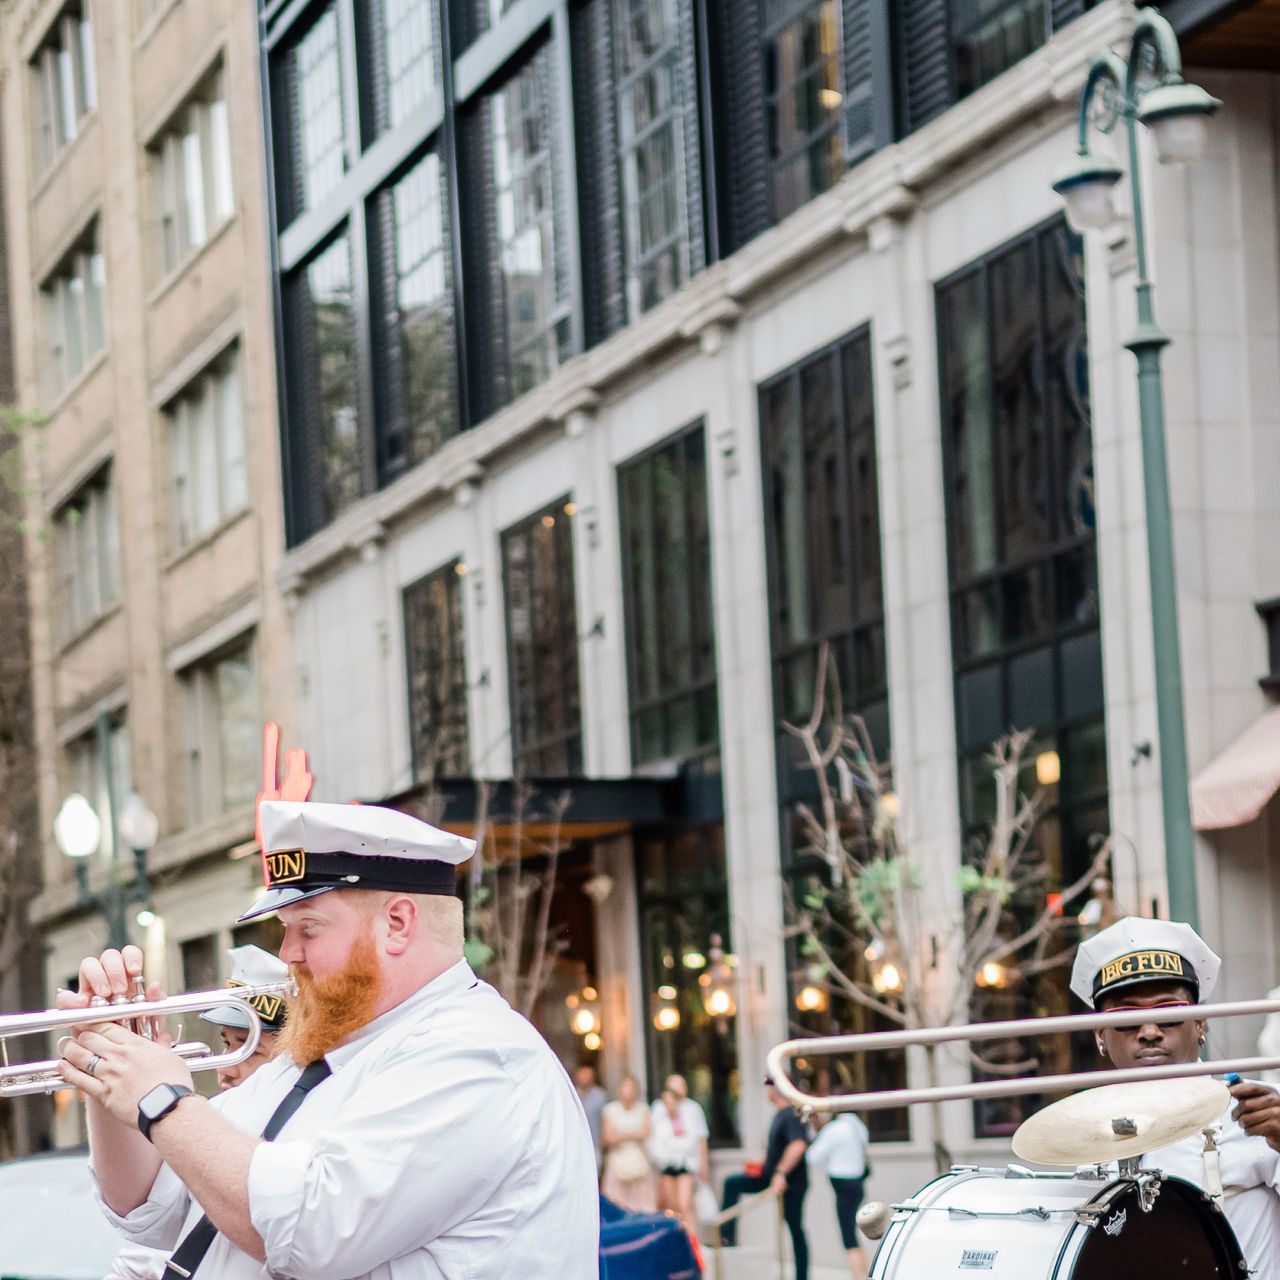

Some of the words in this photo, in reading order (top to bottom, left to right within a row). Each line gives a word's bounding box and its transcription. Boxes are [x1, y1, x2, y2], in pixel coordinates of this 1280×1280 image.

[1105, 957, 1133, 982] BIG
[1137, 953, 1179, 972] FUN
[962, 1251, 996, 1261] CARDINAL
